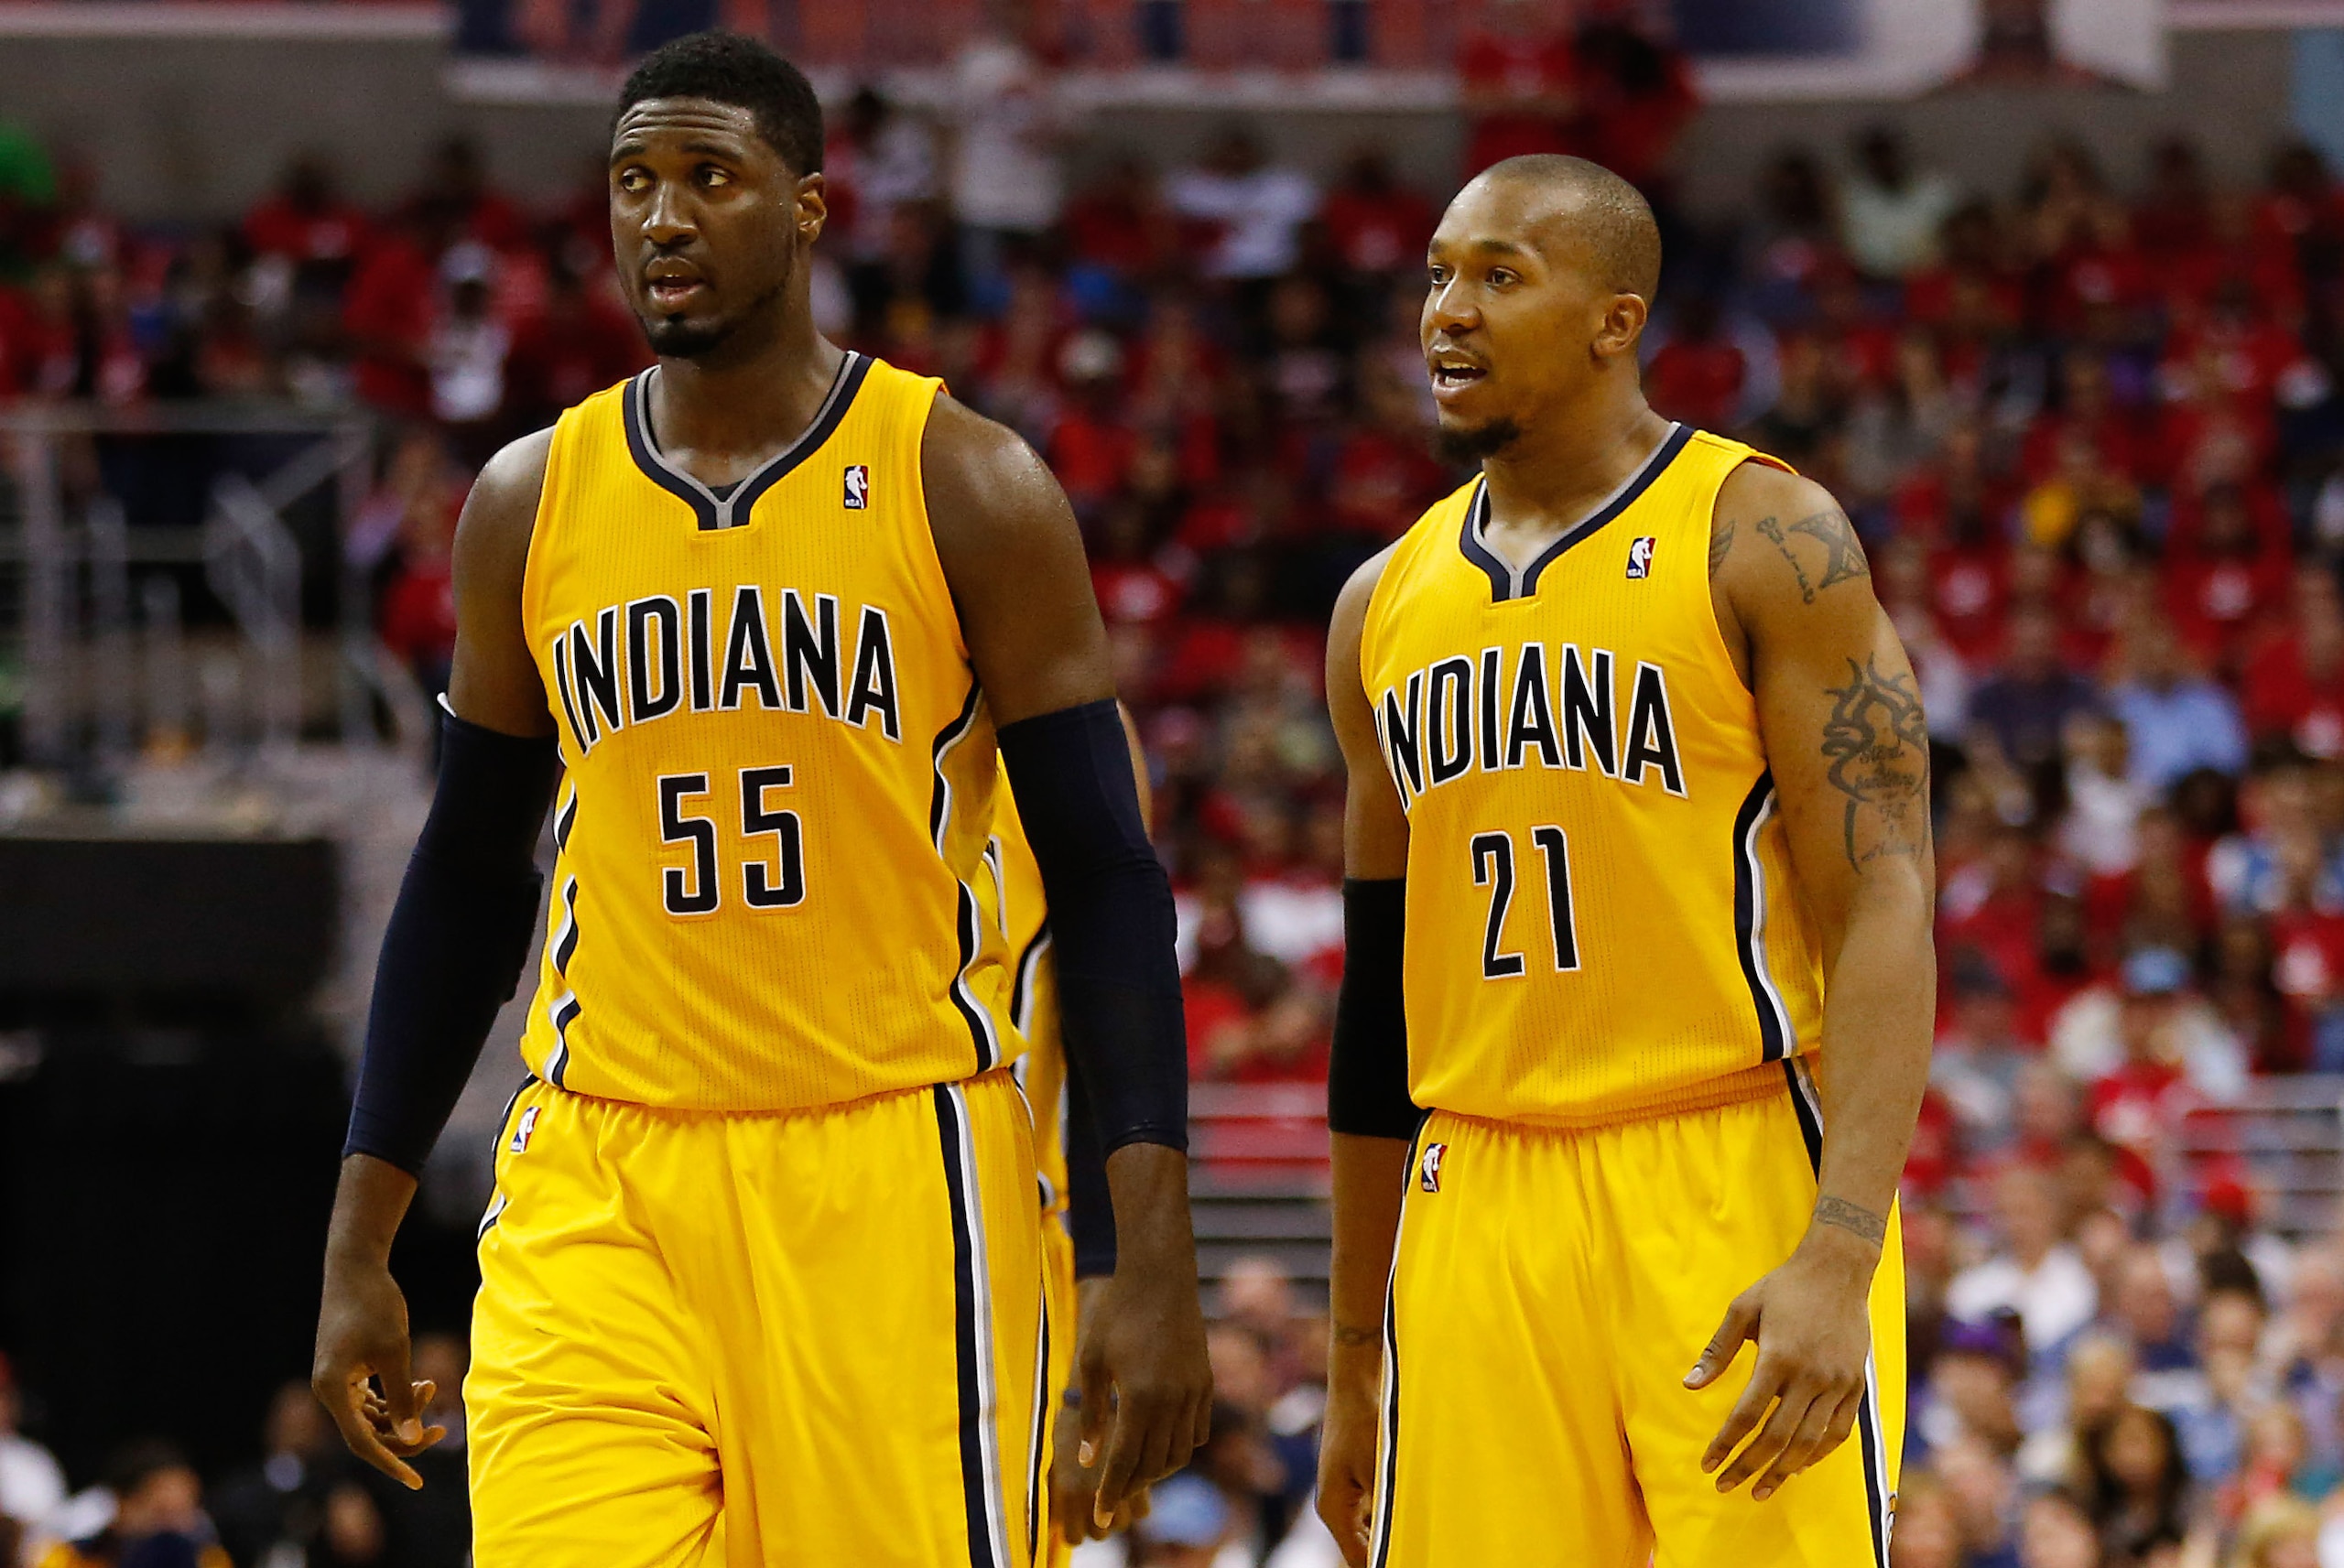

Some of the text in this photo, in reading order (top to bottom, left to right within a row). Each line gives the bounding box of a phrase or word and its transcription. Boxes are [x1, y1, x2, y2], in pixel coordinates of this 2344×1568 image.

[553, 585, 902, 756] INDIANA
[657, 764, 806, 916] 55
[1470, 824, 1581, 980] 21
